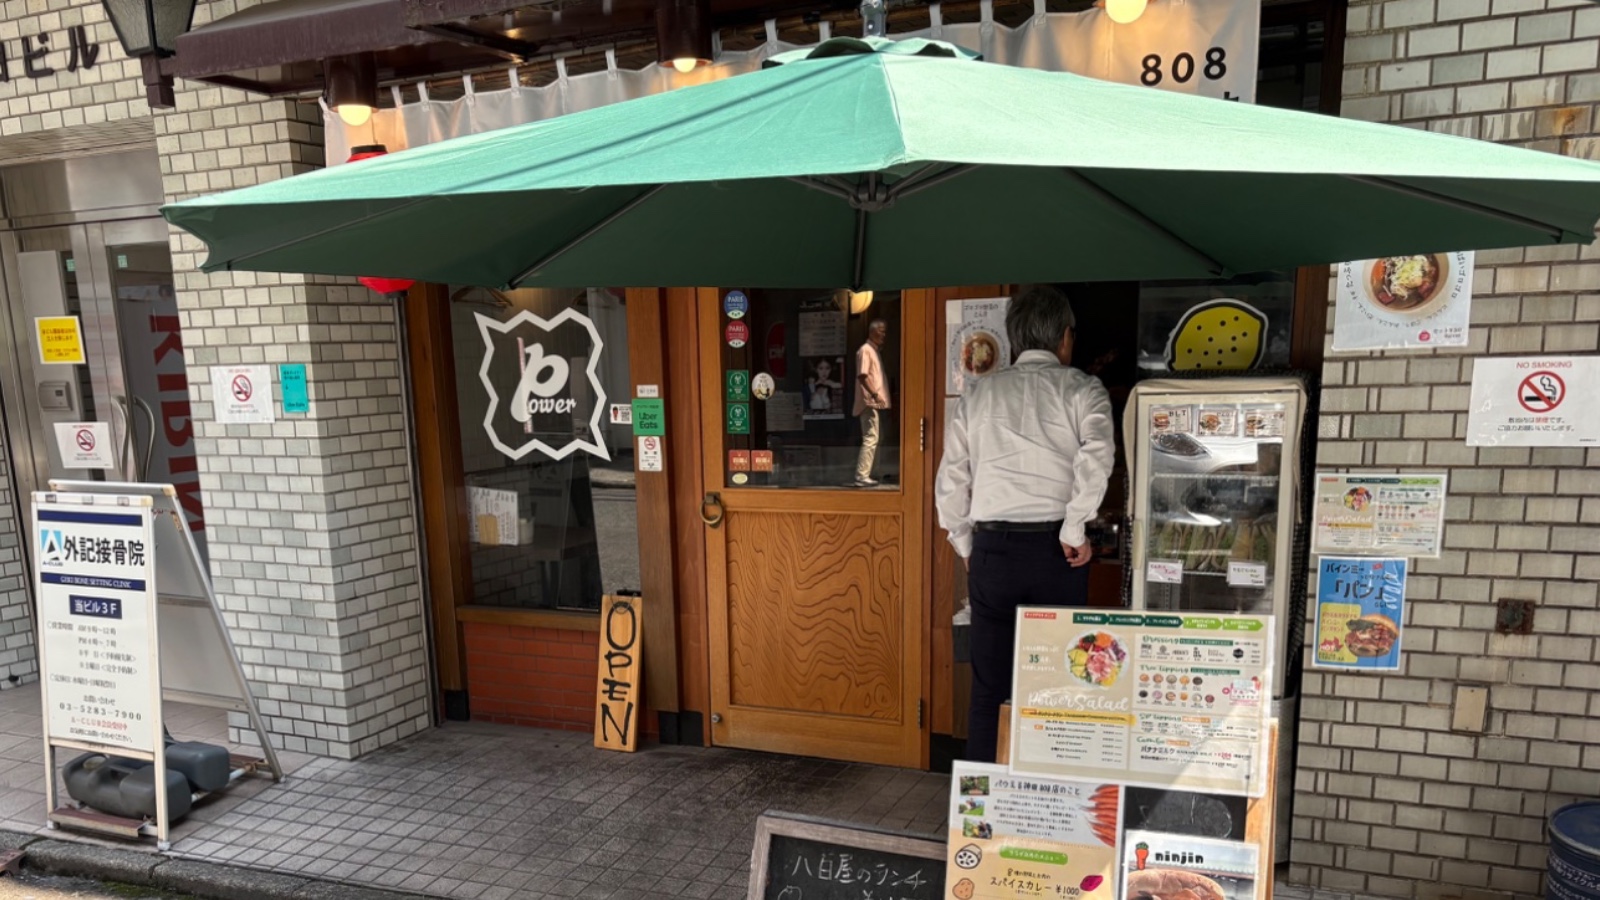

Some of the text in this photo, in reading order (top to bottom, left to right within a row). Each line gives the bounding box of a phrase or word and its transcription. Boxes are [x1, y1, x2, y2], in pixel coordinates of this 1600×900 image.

[0, 25, 99, 83] ビル
[1140, 46, 1227, 86] 808
[1516, 361, 1573, 369] NO SMOKING
[639, 412, 658, 420] Uber
[639, 421, 659, 429] Eats
[63, 535, 145, 566] 外記接骨院
[1326, 563, 1364, 574] バインミー
[1029, 654, 1040, 664] 35
[601, 601, 636, 746] OPEN
[1028, 691, 1074, 708] Power
[1074, 692, 1129, 711] Salad
[1155, 850, 1204, 864] ninjin
[990, 876, 1080, 896] スパイスカレー ¥1000
